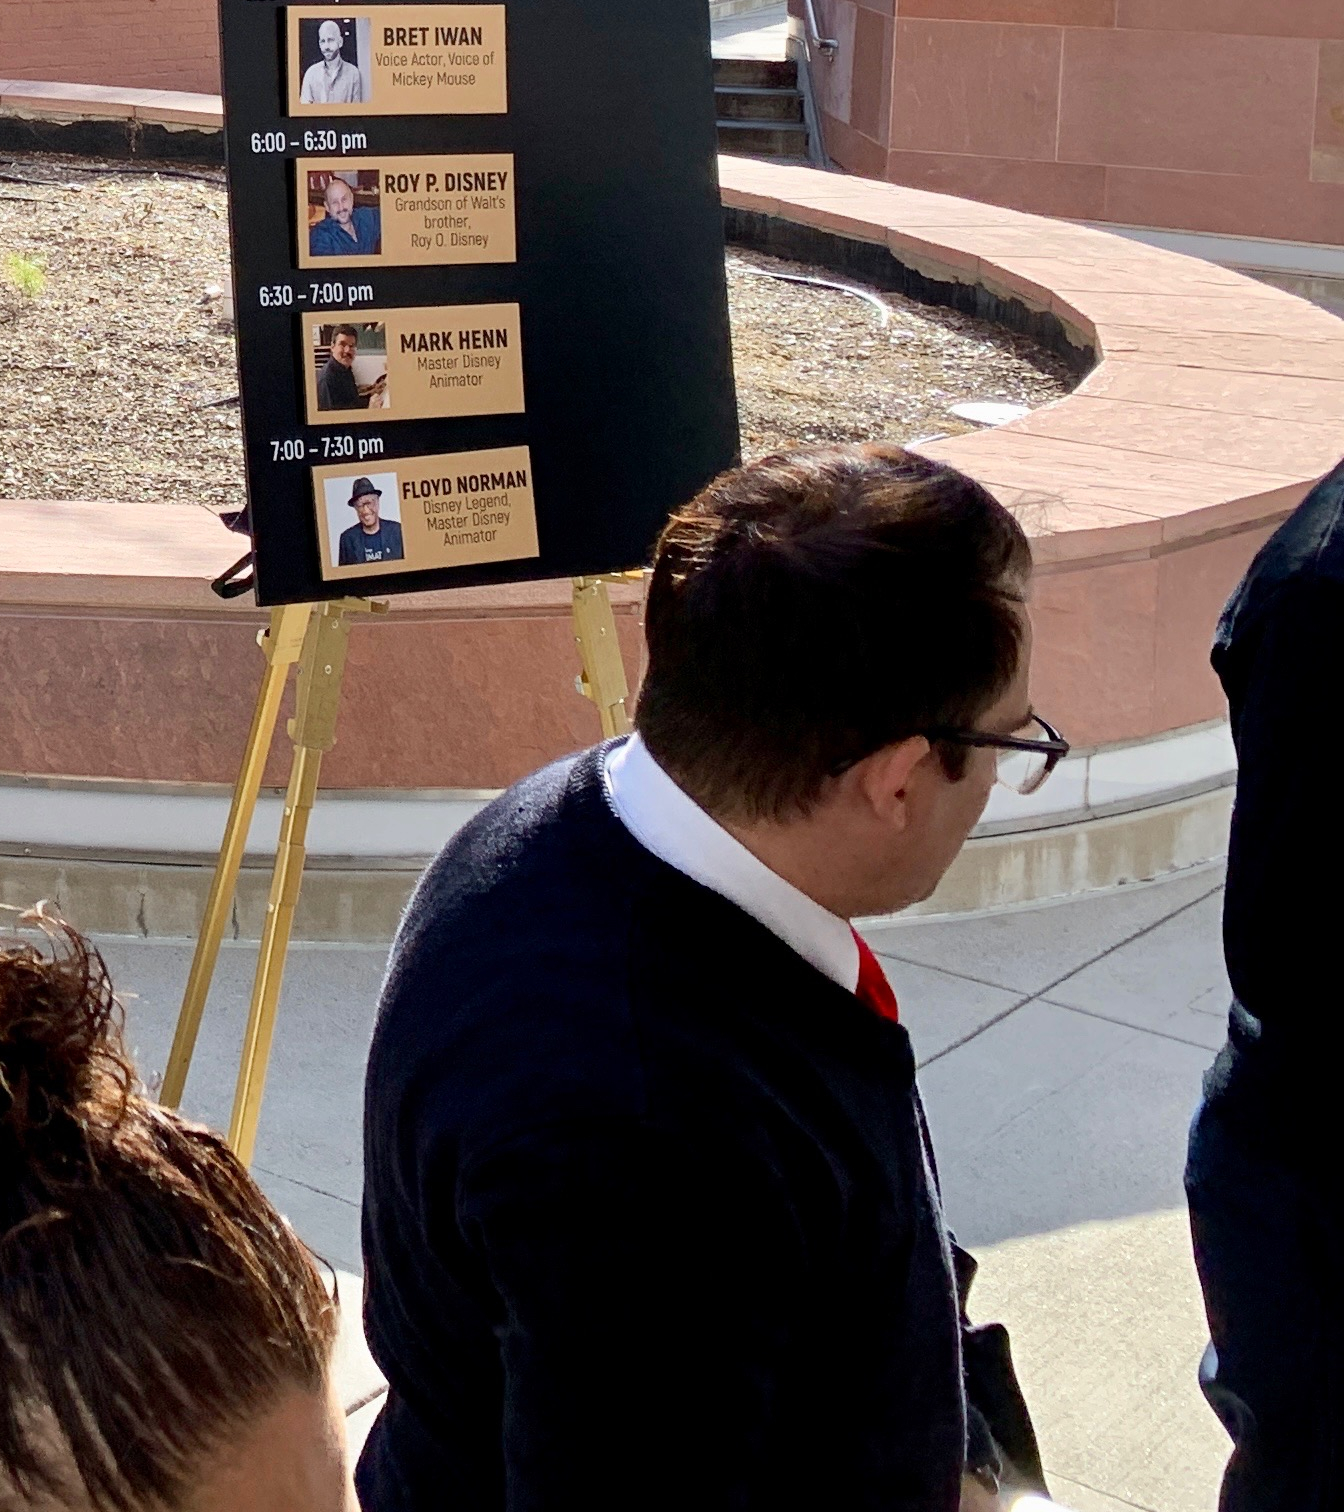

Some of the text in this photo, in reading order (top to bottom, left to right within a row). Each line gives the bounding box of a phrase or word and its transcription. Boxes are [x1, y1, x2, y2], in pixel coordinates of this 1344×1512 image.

[382, 26, 483, 48] BRET IWAN
[374, 50, 495, 69] Voice Actor, Voice of
[250, 129, 368, 154] 6:00 6:30 pm
[383, 171, 509, 195] ROY P. DISNEY
[394, 197, 453, 212] Grandson
[455, 195, 469, 210] of
[259, 282, 375, 308] 6:30 7:00 pm
[399, 328, 509, 354] MARK HENN
[417, 353, 502, 372] Master Disney
[269, 435, 385, 463] 7:00 7:30 pm
[401, 469, 528, 501] FLOYD NORMAN
[422, 492, 512, 516] Disney Legend,
